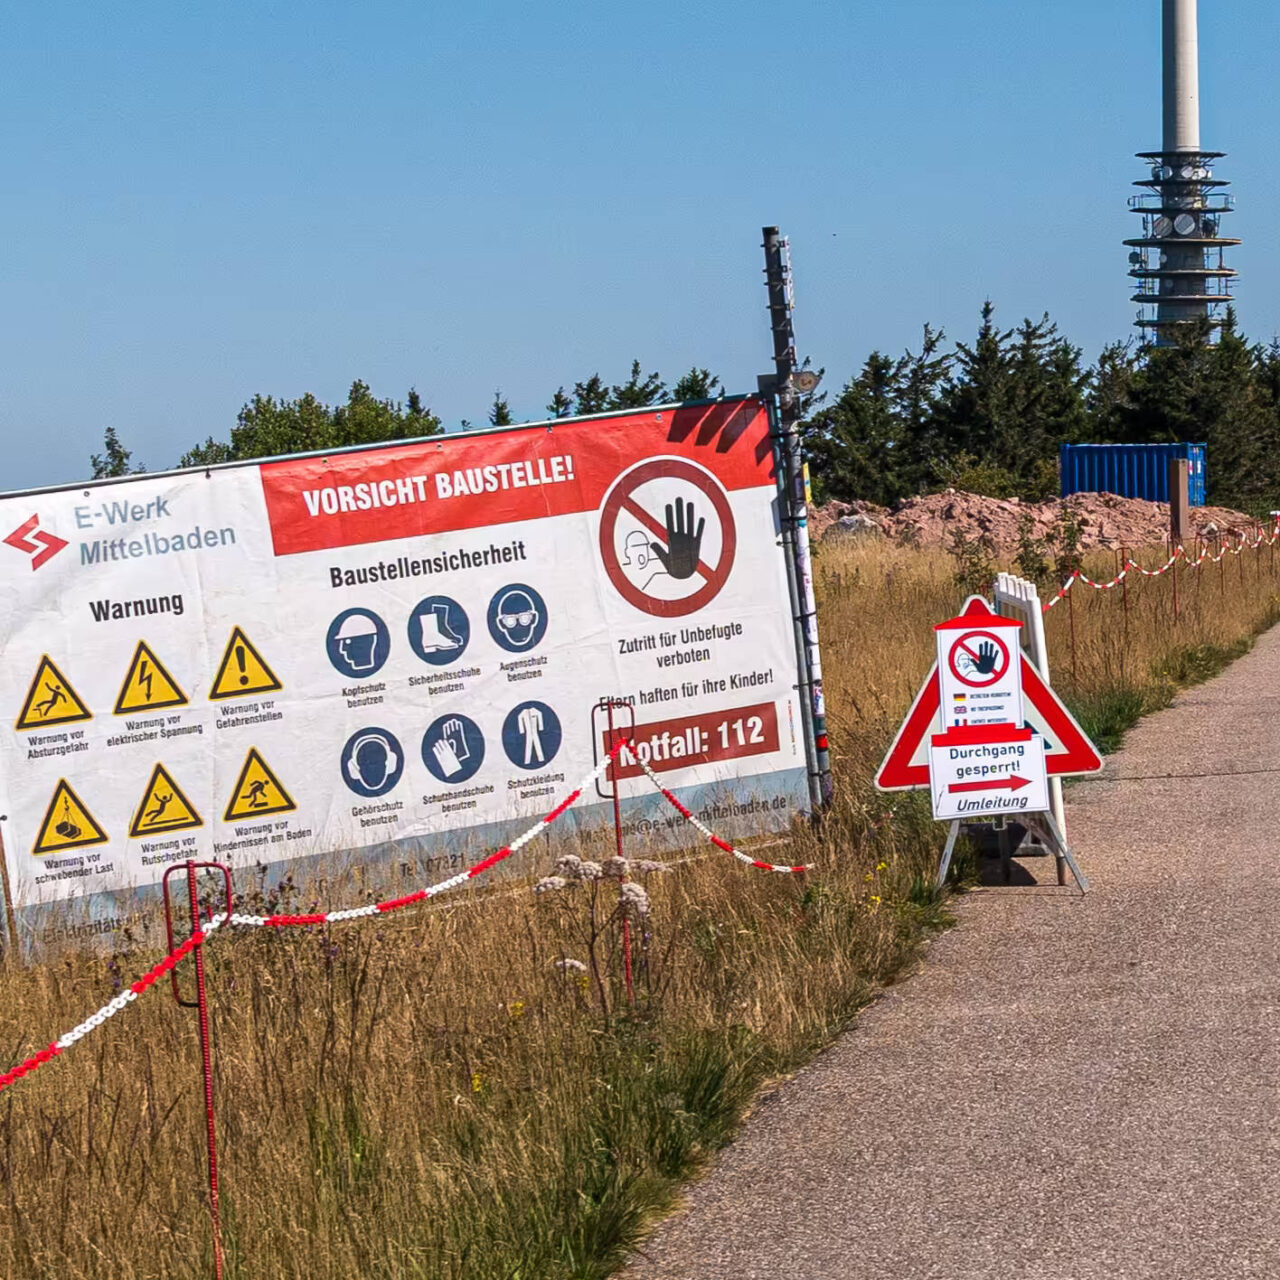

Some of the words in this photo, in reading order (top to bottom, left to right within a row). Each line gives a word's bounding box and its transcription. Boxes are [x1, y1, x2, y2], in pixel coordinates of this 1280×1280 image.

[303, 474, 427, 517] VORSICHT
[436, 455, 575, 497] BAUSTELLE!
[75, 496, 171, 529] E-Werk
[80, 525, 236, 566] Mittelbaden
[330, 540, 526, 588] Baustellensicherheit
[90, 594, 184, 622] Warnung
[618, 635, 657, 654] Zutritt
[659, 632, 677, 648] für
[680, 622, 743, 644] Unbefugte
[656, 648, 710, 668] verboten
[507, 669, 543, 682] benutzen
[342, 681, 386, 697] Kopfschutz
[428, 682, 464, 696] benutzen
[639, 684, 678, 703] haften
[681, 681, 699, 697] für
[702, 677, 726, 694] ihre
[729, 668, 774, 690] Kinder!
[220, 703, 259, 716] Warnung
[261, 701, 275, 710] vor
[347, 695, 384, 708] benutzen
[125, 717, 165, 731] Warnung
[167, 716, 181, 725] vor
[216, 711, 282, 729] Gefahrenstellen
[28, 732, 68, 746] Warnung
[70, 730, 84, 739] vor
[107, 731, 158, 747] elektrischer
[160, 724, 203, 739] Spannung
[619, 726, 710, 768] Notfall:
[717, 716, 765, 749] 112
[28, 742, 89, 759] Absturzgefahr
[950, 745, 1024, 759] Durchgang
[956, 761, 1021, 779] gesperrt!
[507, 772, 565, 790] Schutzkleidung
[352, 800, 403, 817] Gehörschutz
[442, 800, 477, 813] benutzen
[957, 796, 1028, 811] Umleitung
[235, 824, 272, 837] Warnung
[275, 821, 288, 830] vor
[360, 814, 398, 827] benutzen
[141, 839, 180, 853] Warnung
[182, 837, 196, 846] vor
[44, 857, 84, 870] Warnung
[86, 853, 101, 862] vor
[141, 848, 198, 866] Rutschgefahr
[95, 863, 114, 874] Last
